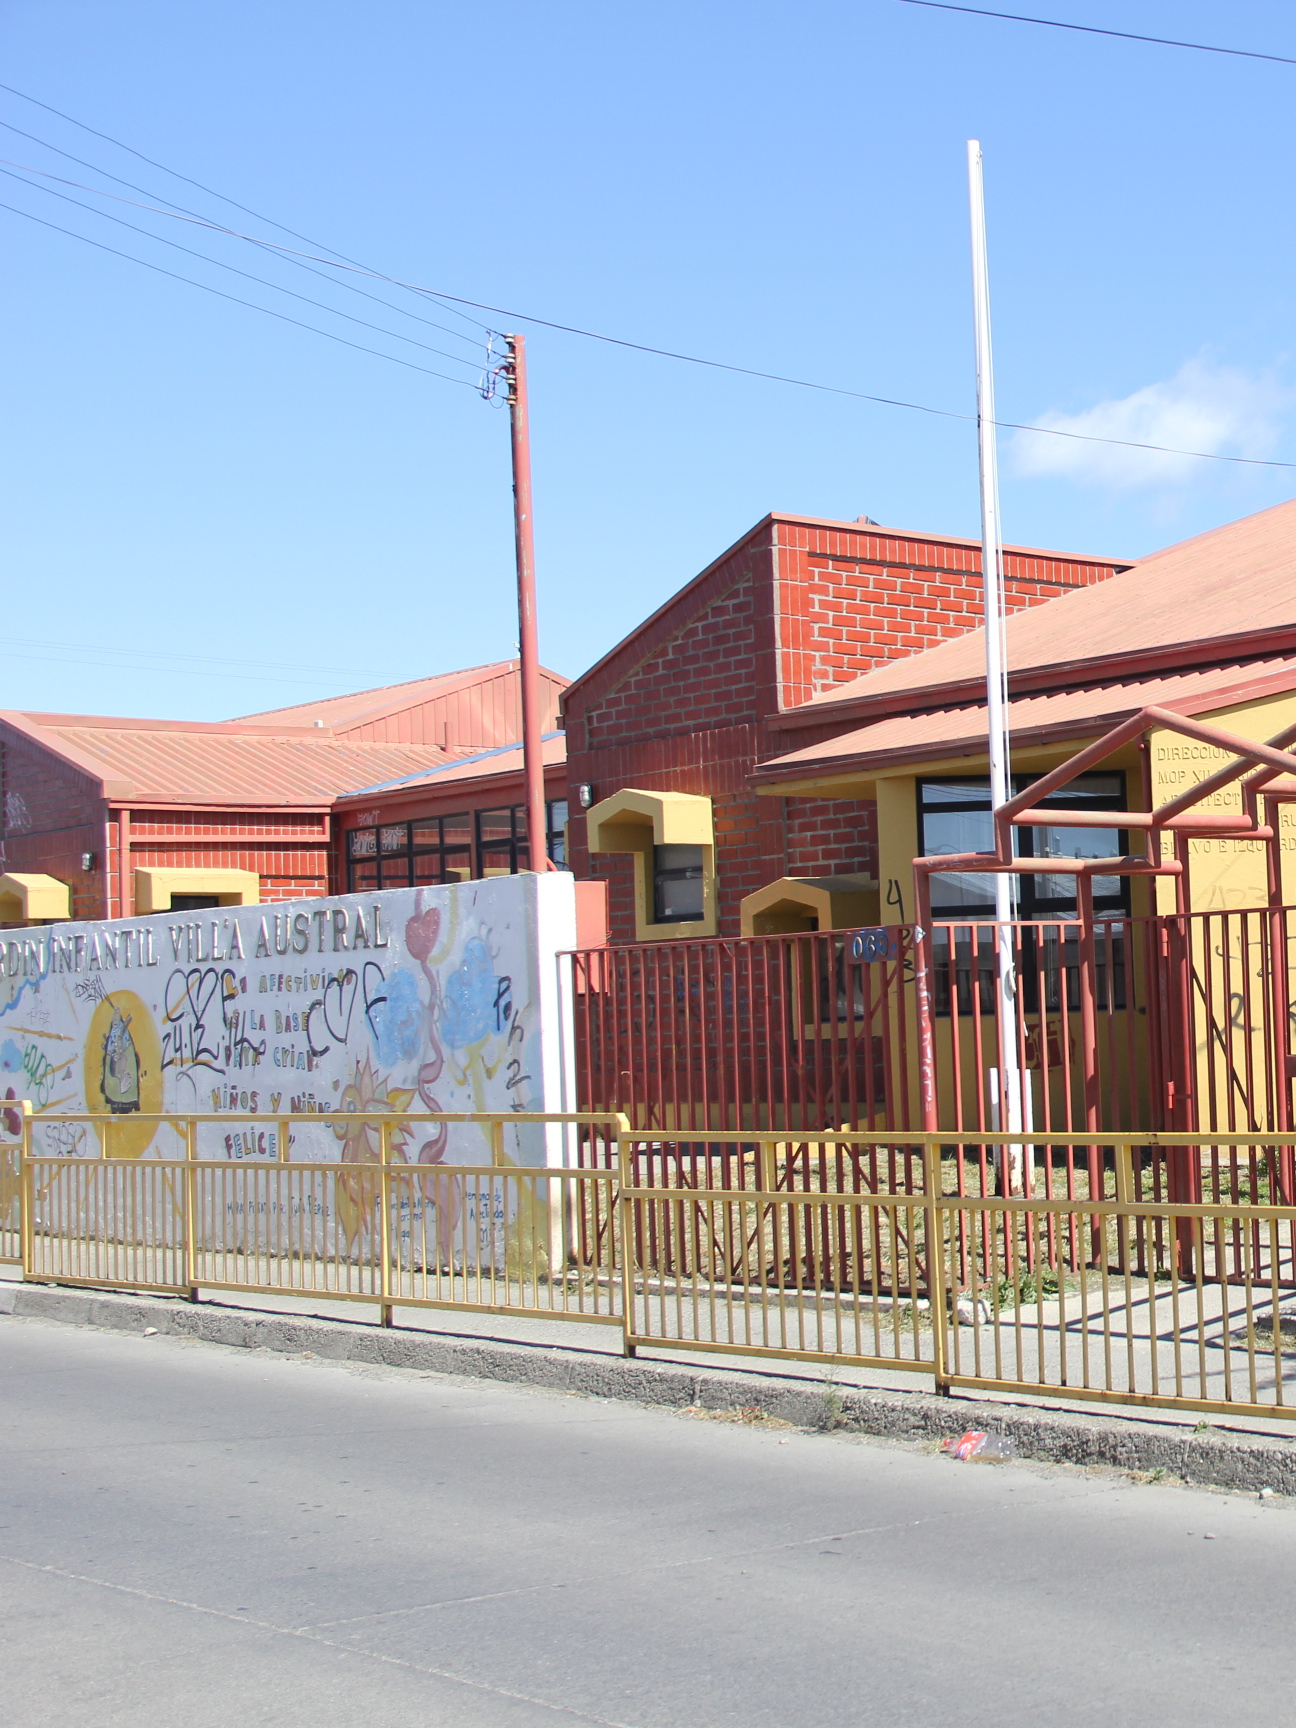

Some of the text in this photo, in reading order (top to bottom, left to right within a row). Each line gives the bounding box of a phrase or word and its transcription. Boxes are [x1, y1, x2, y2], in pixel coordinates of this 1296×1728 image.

[1158, 770, 1187, 784] MOP
[52, 927, 161, 974] INFANTIL
[168, 917, 246, 963] VILLA
[255, 904, 391, 959] AUSTRAL
[275, 1009, 309, 1034] BASE
